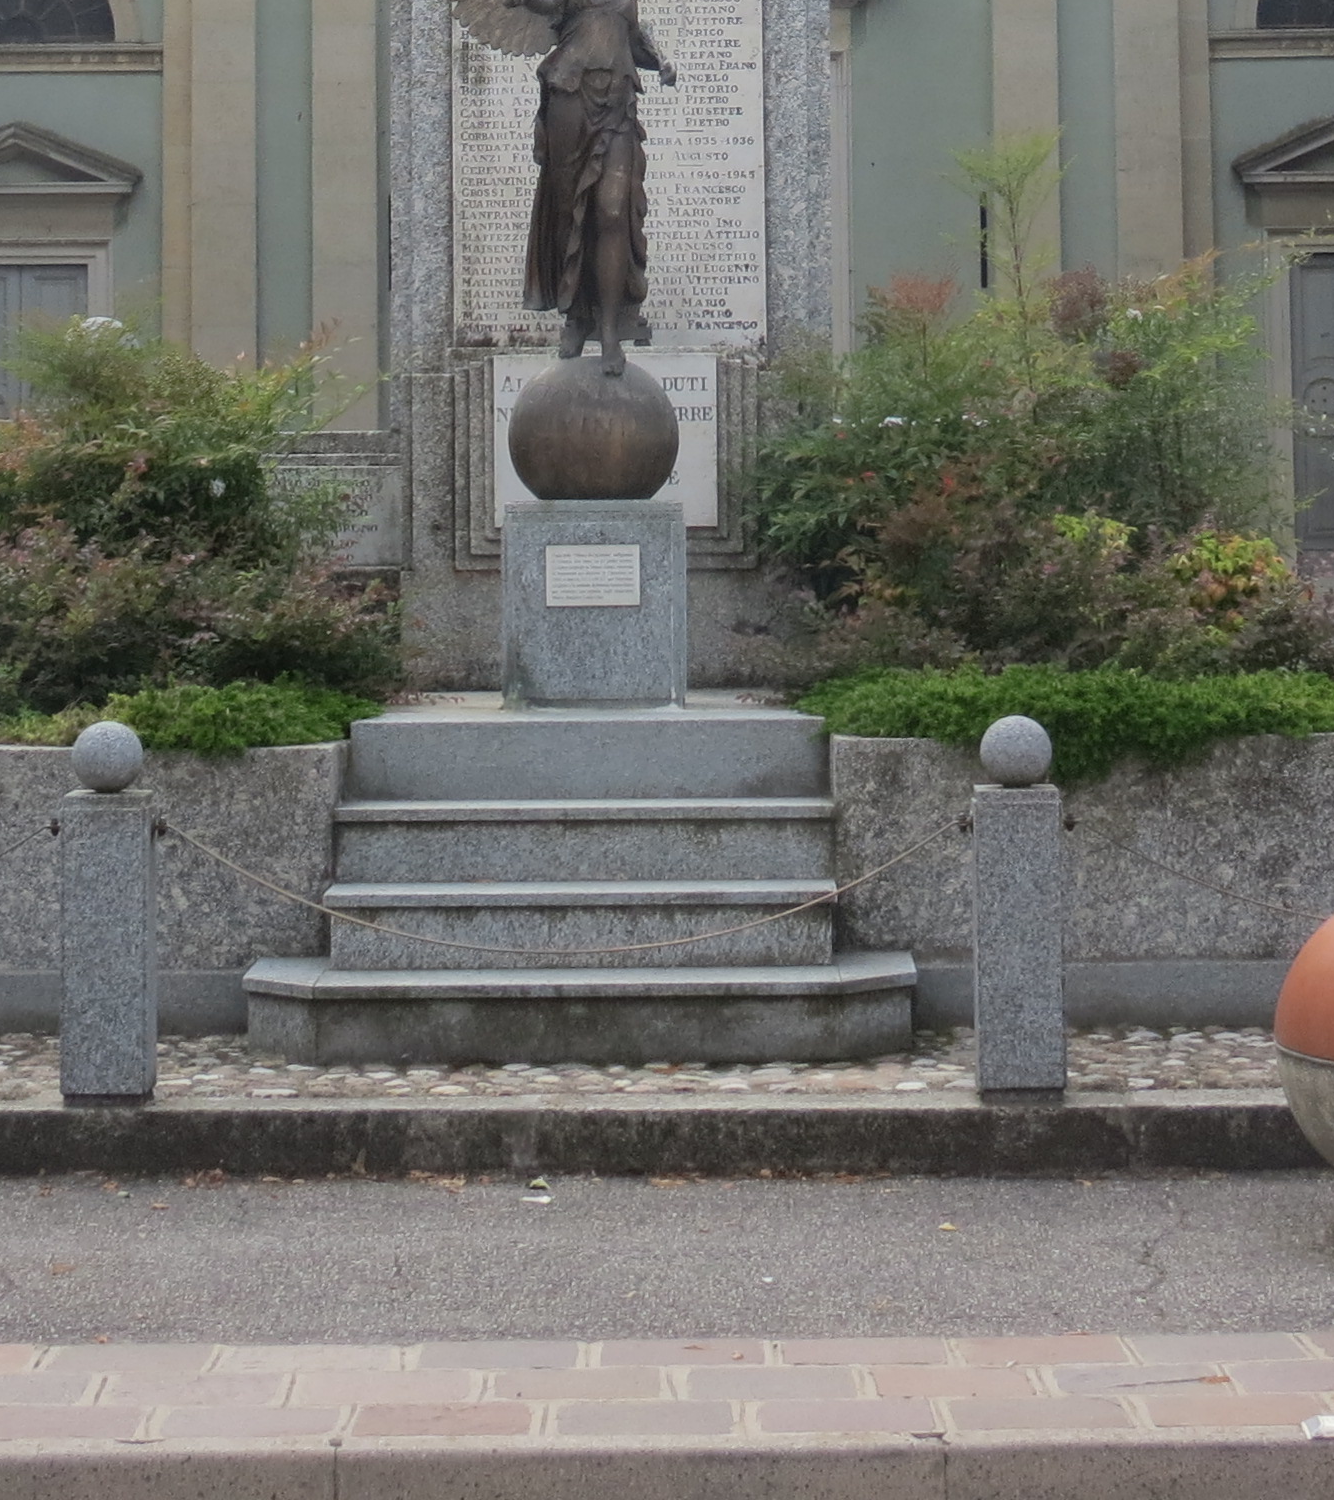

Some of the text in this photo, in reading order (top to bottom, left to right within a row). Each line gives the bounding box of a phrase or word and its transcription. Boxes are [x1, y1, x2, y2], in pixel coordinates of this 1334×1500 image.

[684, 16, 743, 26] VITTORE
[677, 27, 724, 37] ENRICO
[675, 39, 742, 49] MARTIRE
[673, 49, 732, 59] STEFANO
[677, 73, 729, 83] ANGELO
[673, 84, 739, 94] VITTORIO
[460, 97, 504, 108] CAPRA
[685, 95, 729, 105] PIETRO
[460, 108, 505, 119] CAPRA
[637, 106, 743, 116] NETTI GIUSEPPE
[460, 120, 521, 130] CASTELLI
[641, 118, 730, 128] ETTI PIETRO
[647, 170, 685, 180] ERRA
[675, 183, 746, 195] FRANCESCO
[667, 195, 741, 206] SALVATORE
[668, 208, 714, 218] MARIO
[717, 217, 742, 228] IMO
[462, 233, 527, 242] MAFFEZZO
[648, 230, 760, 240] TINELLI ATTILIO
[656, 241, 733, 252] FRANCESCO
[691, 252, 756, 262] DEMETRIO
[647, 263, 759, 274] RNESCHI EUGENIO
[687, 275, 760, 285] VITTORINO
[462, 288, 524, 298] MALINVE
[649, 286, 729, 297] GNOLI LUIGI
[462, 300, 522, 310] MARCHET
[681, 298, 727, 308] MARIO
[675, 308, 733, 319] SOSPIRO
[687, 320, 758, 331] FRANCESCO
[660, 376, 709, 392] DUTI
[674, 406, 714, 422] RRE
